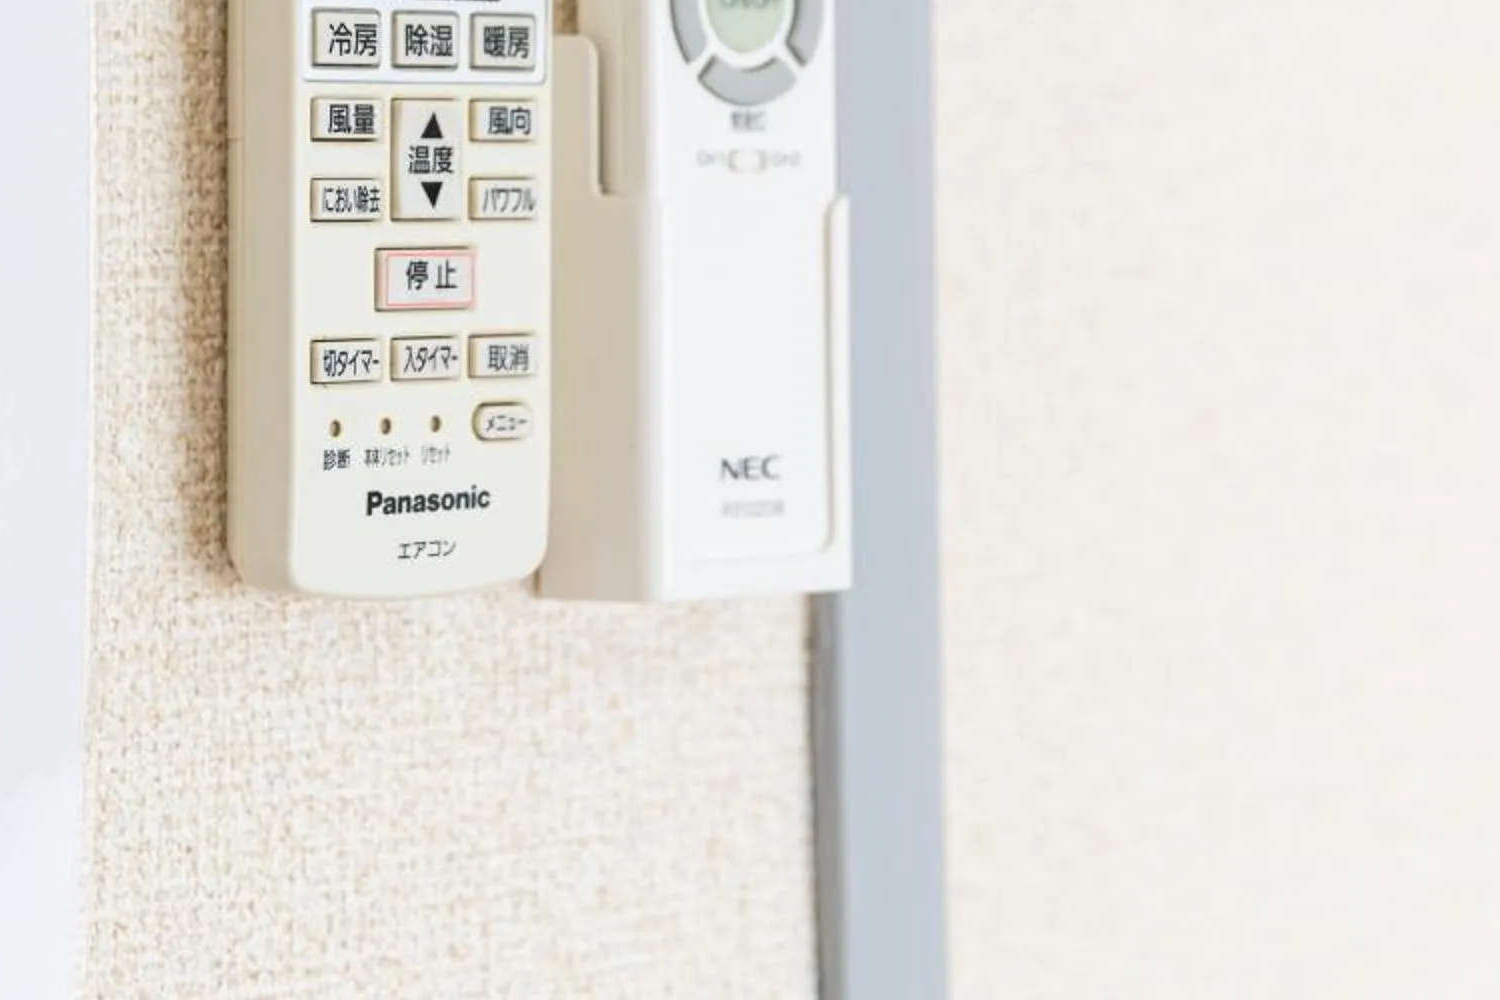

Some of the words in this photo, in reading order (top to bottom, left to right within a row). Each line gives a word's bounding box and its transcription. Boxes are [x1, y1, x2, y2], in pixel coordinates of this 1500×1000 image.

[328, 22, 378, 57] 冷房
[404, 24, 453, 57] 除湿
[483, 26, 531, 58] 暖房
[327, 104, 375, 134] 風量
[487, 106, 532, 135] 風向
[408, 144, 454, 174] 温度
[482, 187, 537, 213] パワフル
[405, 260, 458, 291] 停止
[323, 348, 380, 377] 切タイマー
[403, 346, 459, 373] 入タイマー
[487, 343, 530, 372] 取消
[485, 414, 528, 433] メニュー
[719, 454, 782, 481] NEC
[365, 484, 491, 516] Panasonic
[397, 540, 457, 560] エアコン
